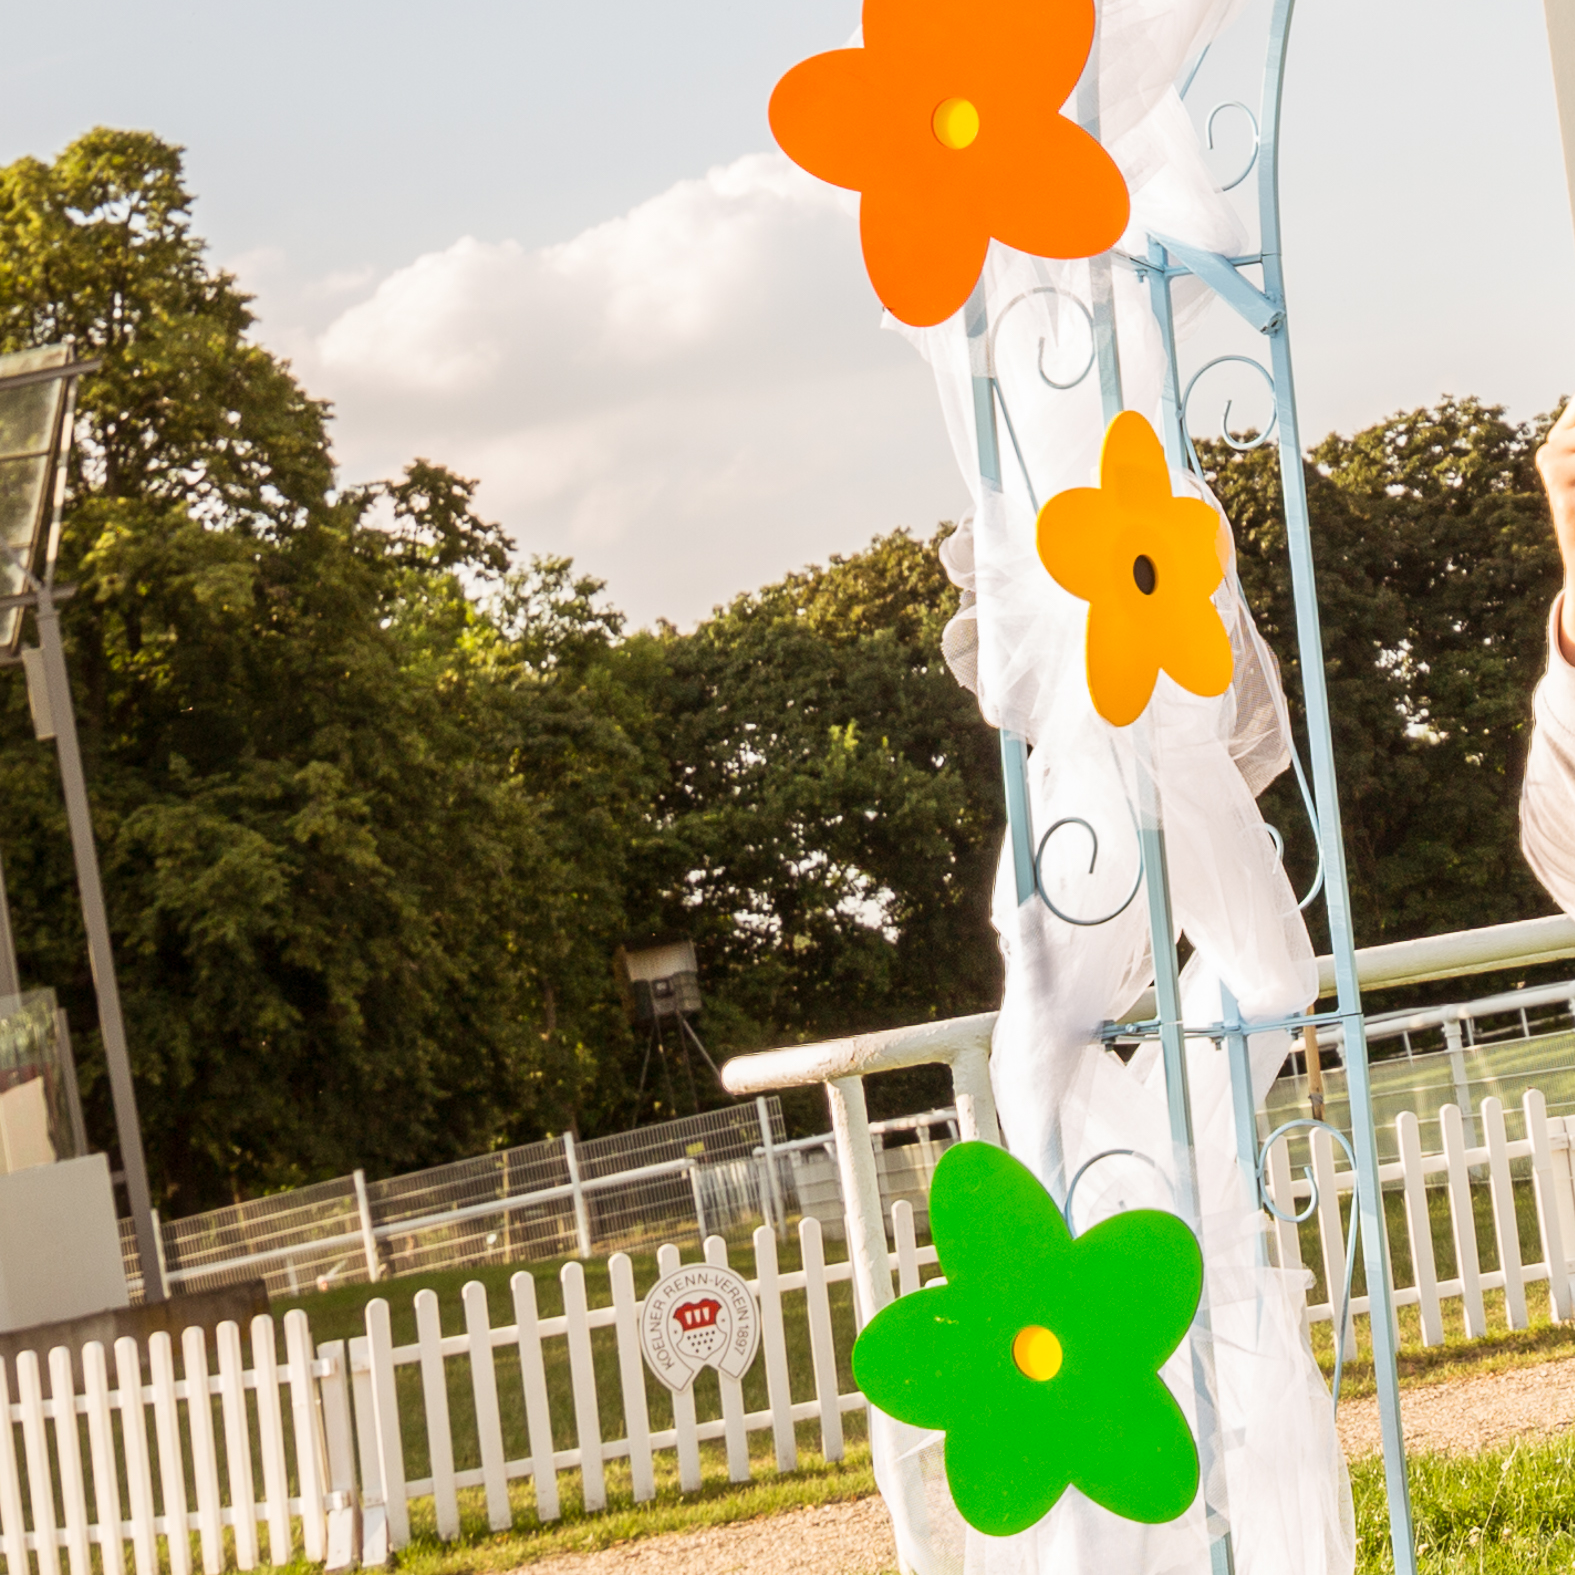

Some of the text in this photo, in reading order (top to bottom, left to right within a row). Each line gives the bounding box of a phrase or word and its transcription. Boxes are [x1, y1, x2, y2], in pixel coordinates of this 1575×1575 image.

[650, 1273, 749, 1370] KOELNER RENN-VEREIN 1897
